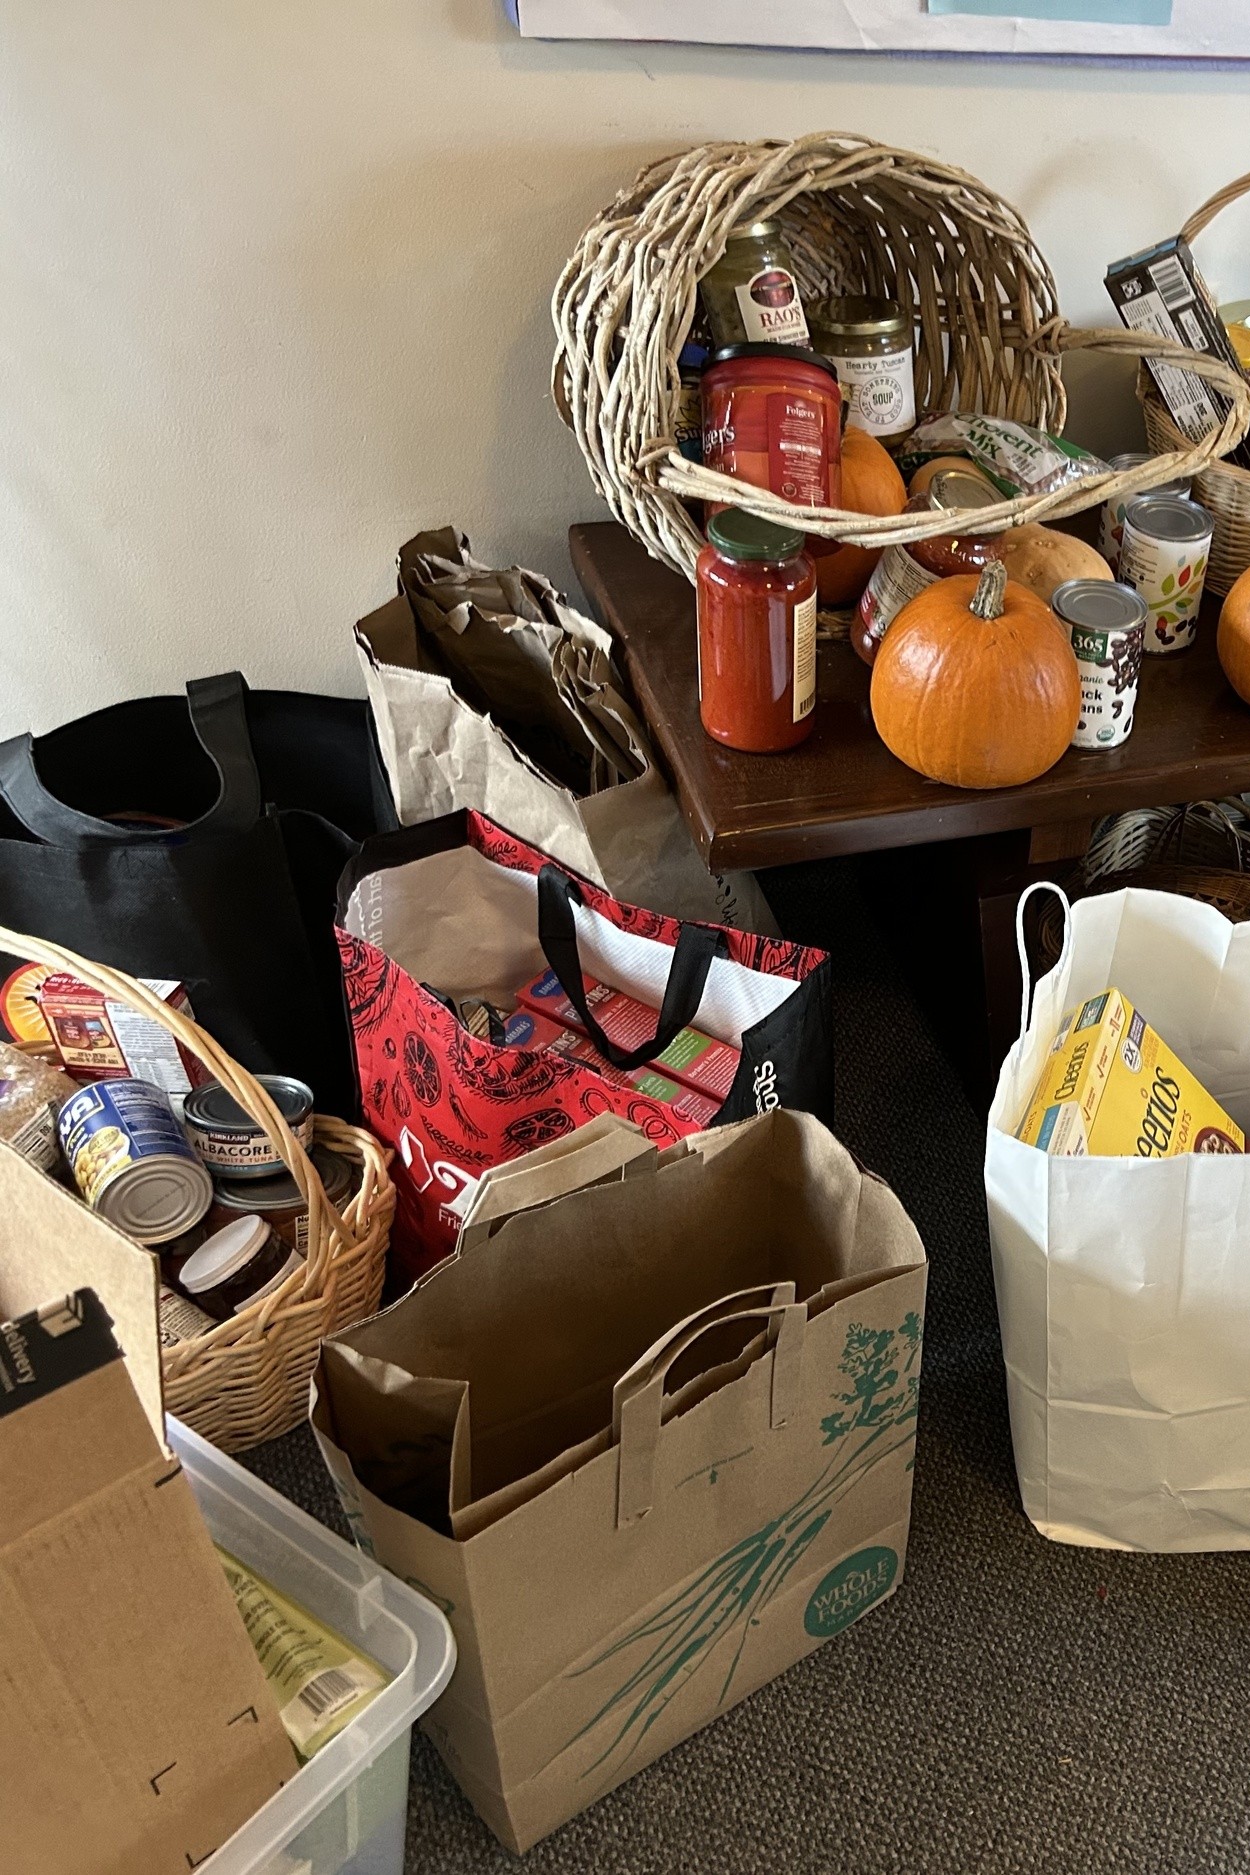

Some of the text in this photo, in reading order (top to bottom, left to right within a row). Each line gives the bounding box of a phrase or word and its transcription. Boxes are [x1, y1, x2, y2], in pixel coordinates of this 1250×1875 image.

[846, 361, 878, 372] Hearty
[872, 392, 894, 406] SOUP
[786, 405, 816, 419] Folgers
[702, 423, 735, 454] lgers
[967, 430, 1002, 459] Mix
[1074, 634, 1104, 653] 365
[1081, 704, 1103, 714] ans
[1123, 1045, 1137, 1065] 2X
[1054, 1041, 1089, 1101] Cheerios
[756, 1060, 781, 1110] Sho
[59, 1096, 98, 1134] YA
[1134, 1066, 1181, 1159] eerios
[209, 1132, 249, 1143] KIRKLAND
[194, 1139, 272, 1157] ALBACORE
[217, 1155, 245, 1164] WHITE
[249, 1155, 273, 1164] TUNA
[813, 1557, 890, 1609] WHOLE
[818, 1572, 888, 1624] FOODS
